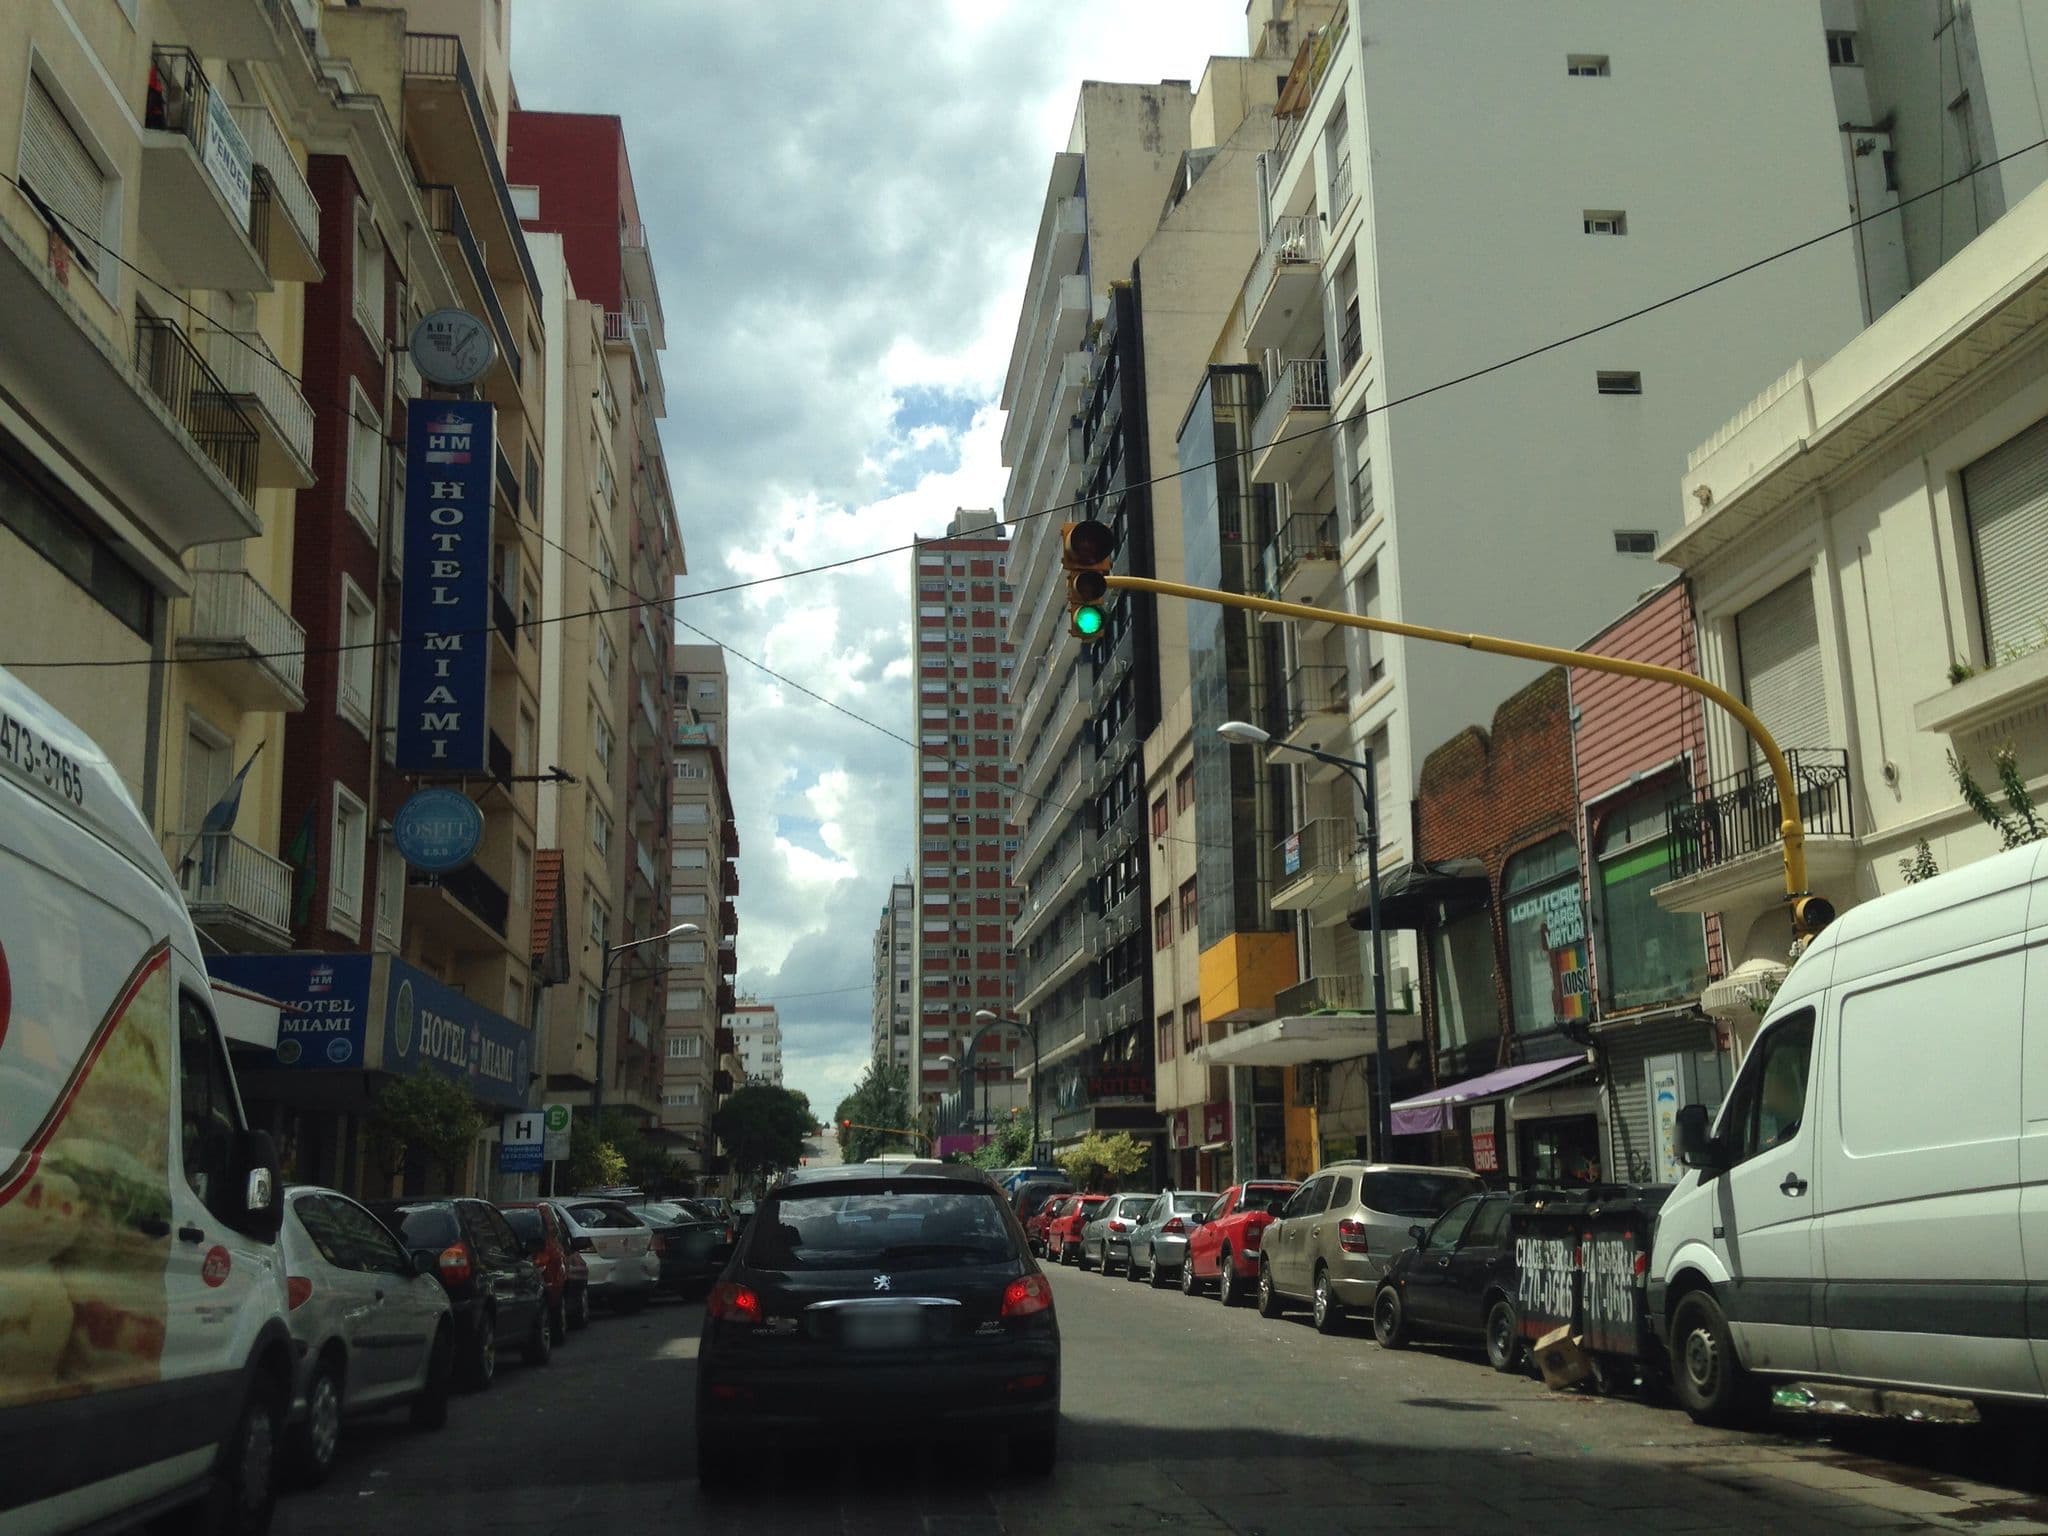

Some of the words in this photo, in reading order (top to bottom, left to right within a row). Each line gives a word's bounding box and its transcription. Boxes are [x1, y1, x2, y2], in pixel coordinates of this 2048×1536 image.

[211, 122, 249, 199] VENDEN
[430, 436, 470, 450] HM
[430, 481, 464, 605] HOTEL
[420, 632, 463, 758] MIAMI
[1511, 883, 1581, 924] LOCUTORIO
[1546, 903, 1583, 929] CARGA
[283, 1018, 351, 1032] MIAMI
[419, 1009, 467, 1067] HOTEL
[516, 1120, 531, 1139] H
